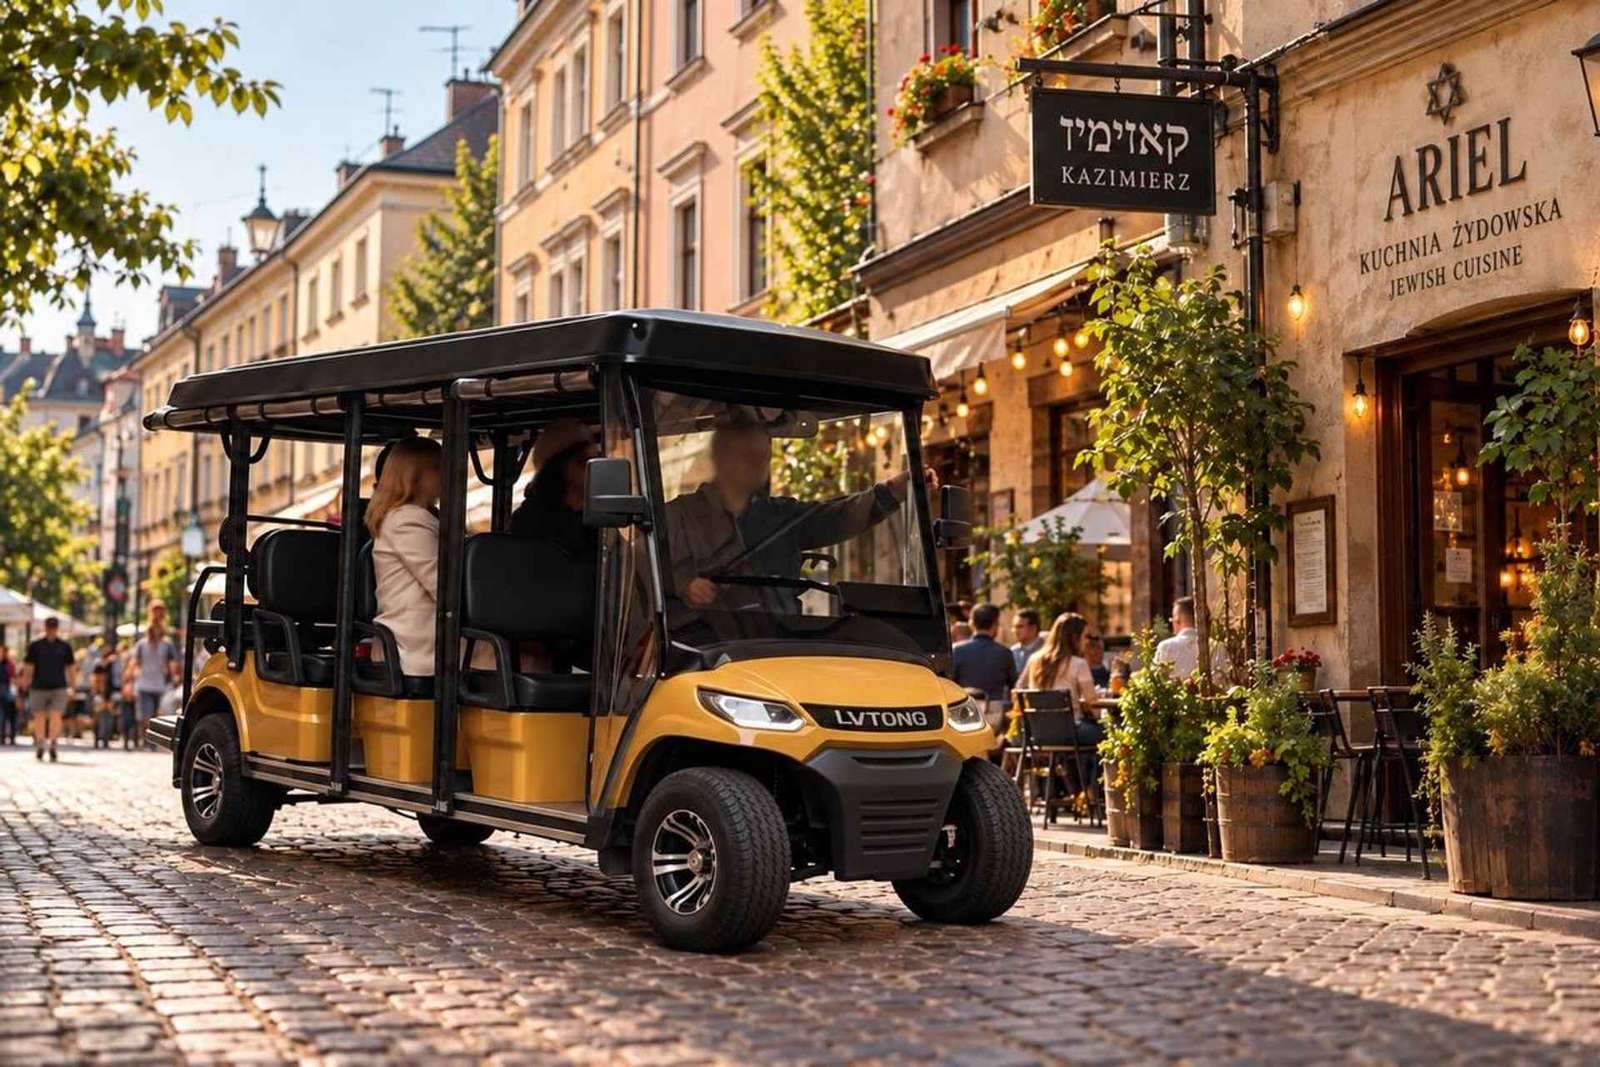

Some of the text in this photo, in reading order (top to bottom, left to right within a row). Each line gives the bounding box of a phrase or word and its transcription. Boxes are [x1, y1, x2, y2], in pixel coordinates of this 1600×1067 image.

[1061, 166, 1190, 191] KAZIMIERZ
[1384, 116, 1527, 222] ARIEL
[1360, 197, 1562, 275] KUCHNIA ŻYDOWSKA
[1388, 245, 1523, 301] JEWISH CUISINE
[834, 709, 928, 727] LVTONG
